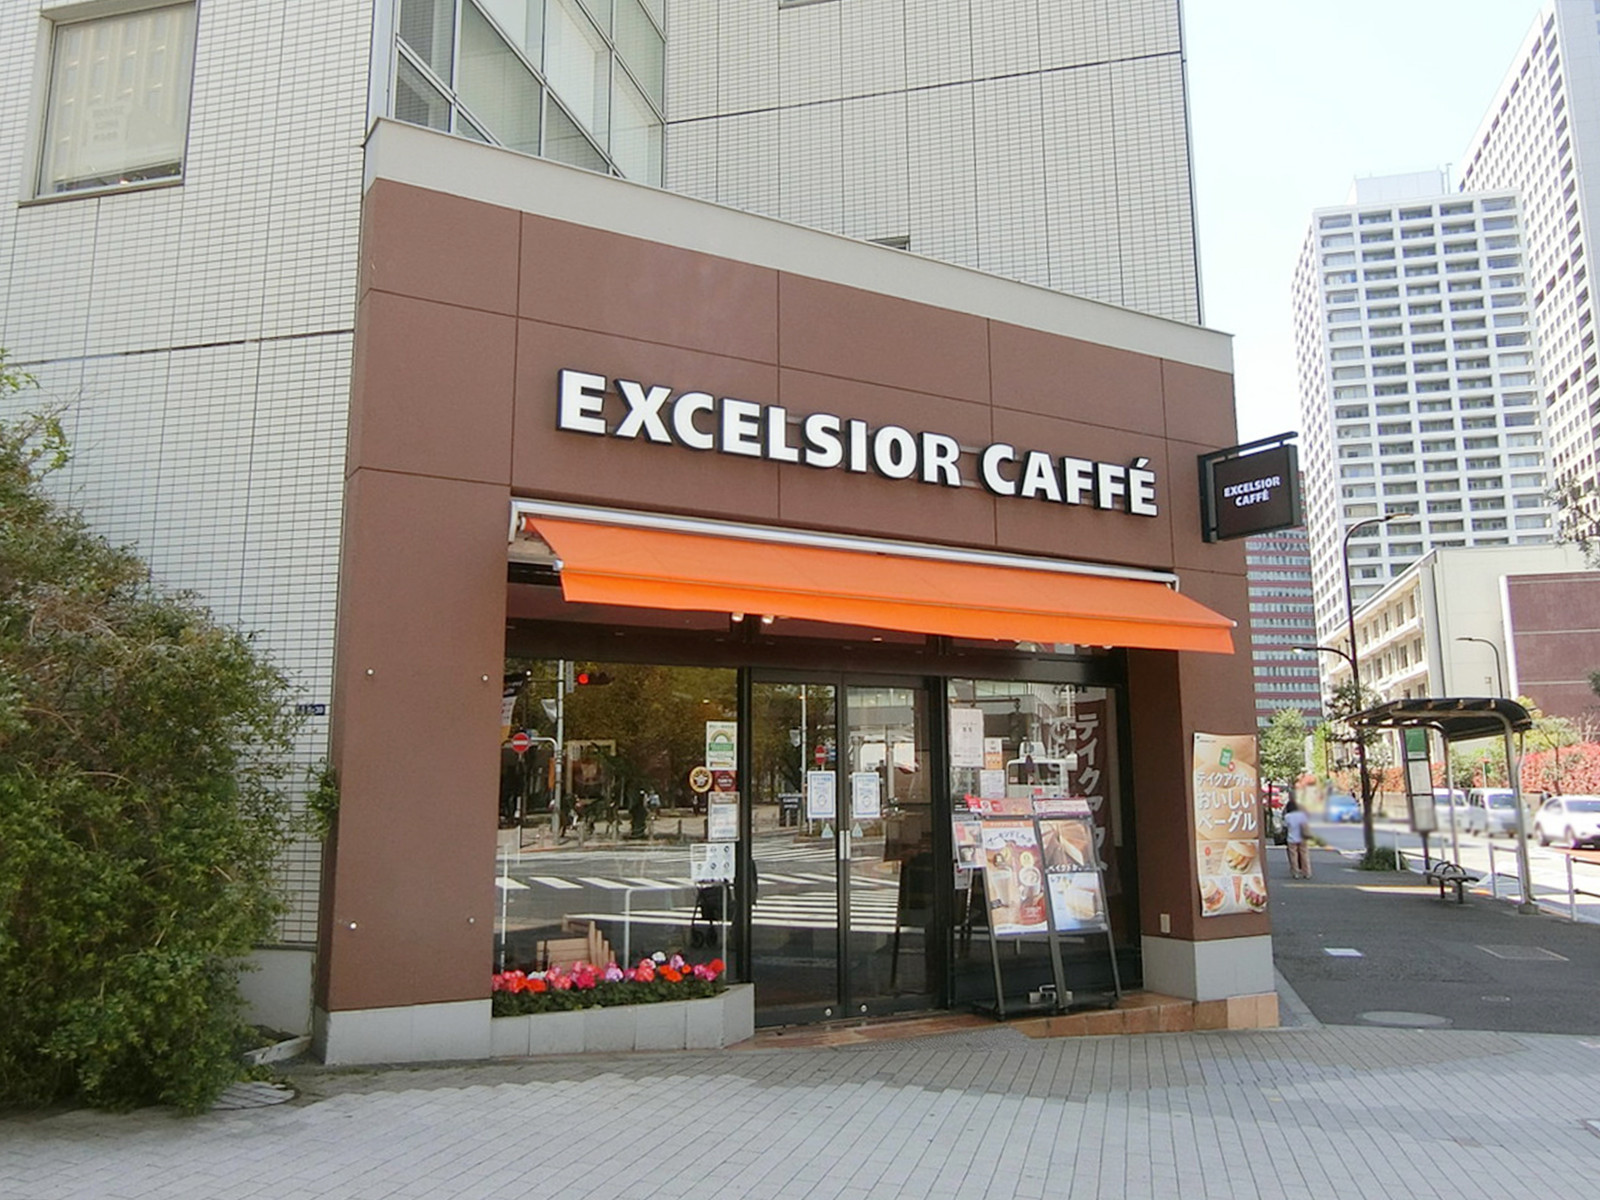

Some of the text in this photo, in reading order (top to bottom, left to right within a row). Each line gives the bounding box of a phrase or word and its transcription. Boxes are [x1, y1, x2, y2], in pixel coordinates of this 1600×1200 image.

[558, 367, 1158, 516] EXCELSIOR CAFFÉ
[1223, 475, 1281, 498] EXCELSIOR
[1235, 488, 1270, 507] CAFFÉ
[1075, 713, 1109, 871] テイクア
[1197, 788, 1256, 810] おいしい
[1198, 810, 1257, 833] ベーグル
